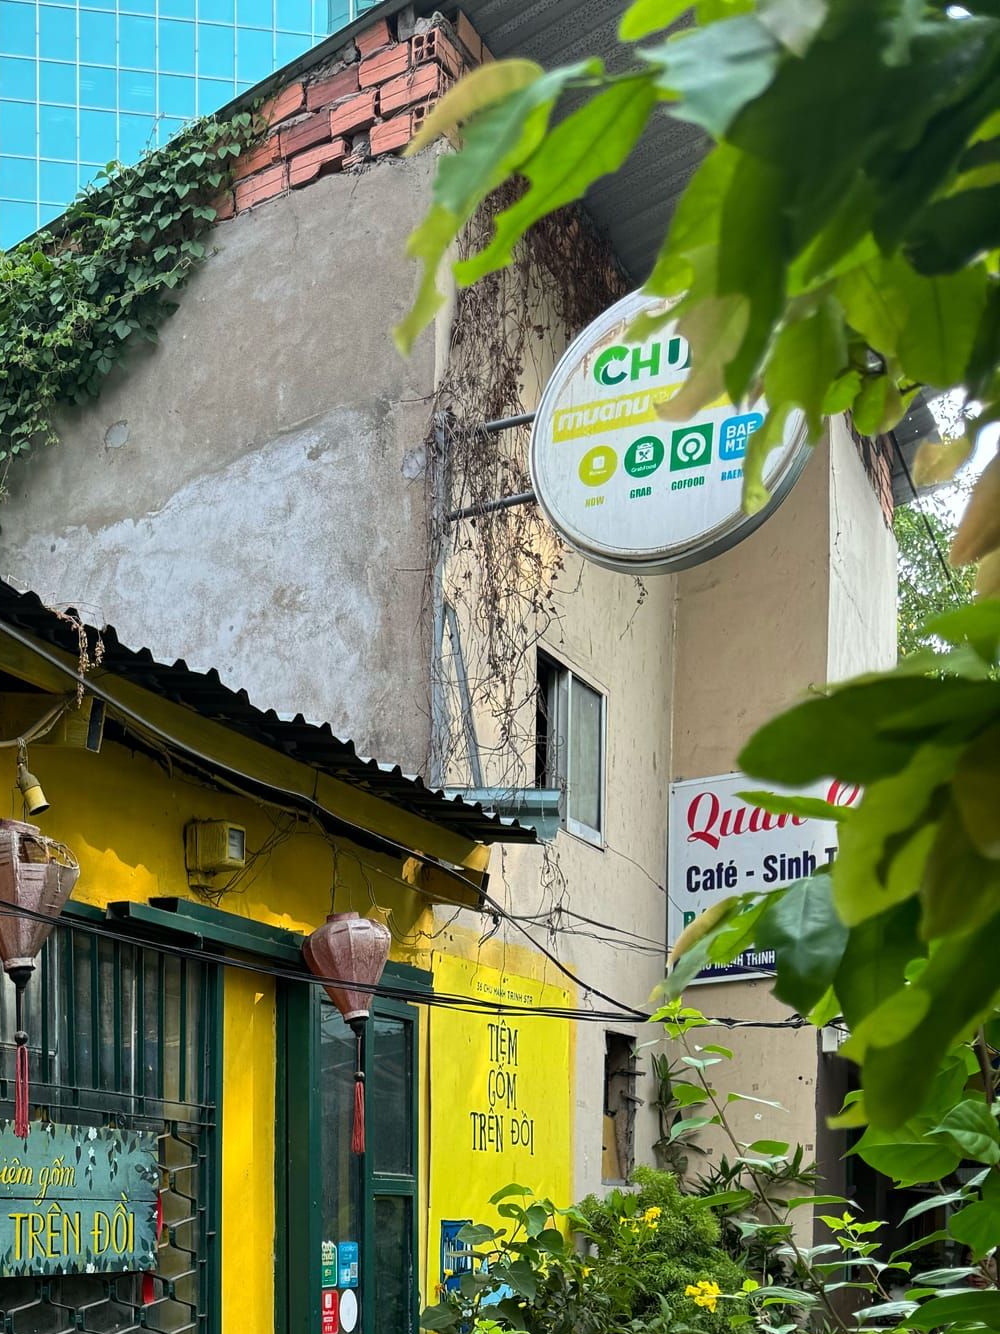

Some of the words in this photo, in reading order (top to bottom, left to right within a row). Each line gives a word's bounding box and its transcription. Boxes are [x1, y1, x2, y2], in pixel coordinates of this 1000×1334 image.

[725, 437, 745, 453] MI
[630, 487, 652, 499] GRAB
[671, 476, 705, 491] GOFOOD
[686, 860, 738, 893] Café
[763, 850, 816, 883] Sinh
[487, 1019, 519, 1066] TIỆM
[488, 1063, 517, 1110] GỐM
[470, 1108, 504, 1153] TRÊN
[510, 1110, 534, 1155] ĐỒI
[33, 1154, 77, 1206] gốm
[8, 1201, 81, 1261] TRÊN
[89, 1192, 135, 1255] ĐỒI
